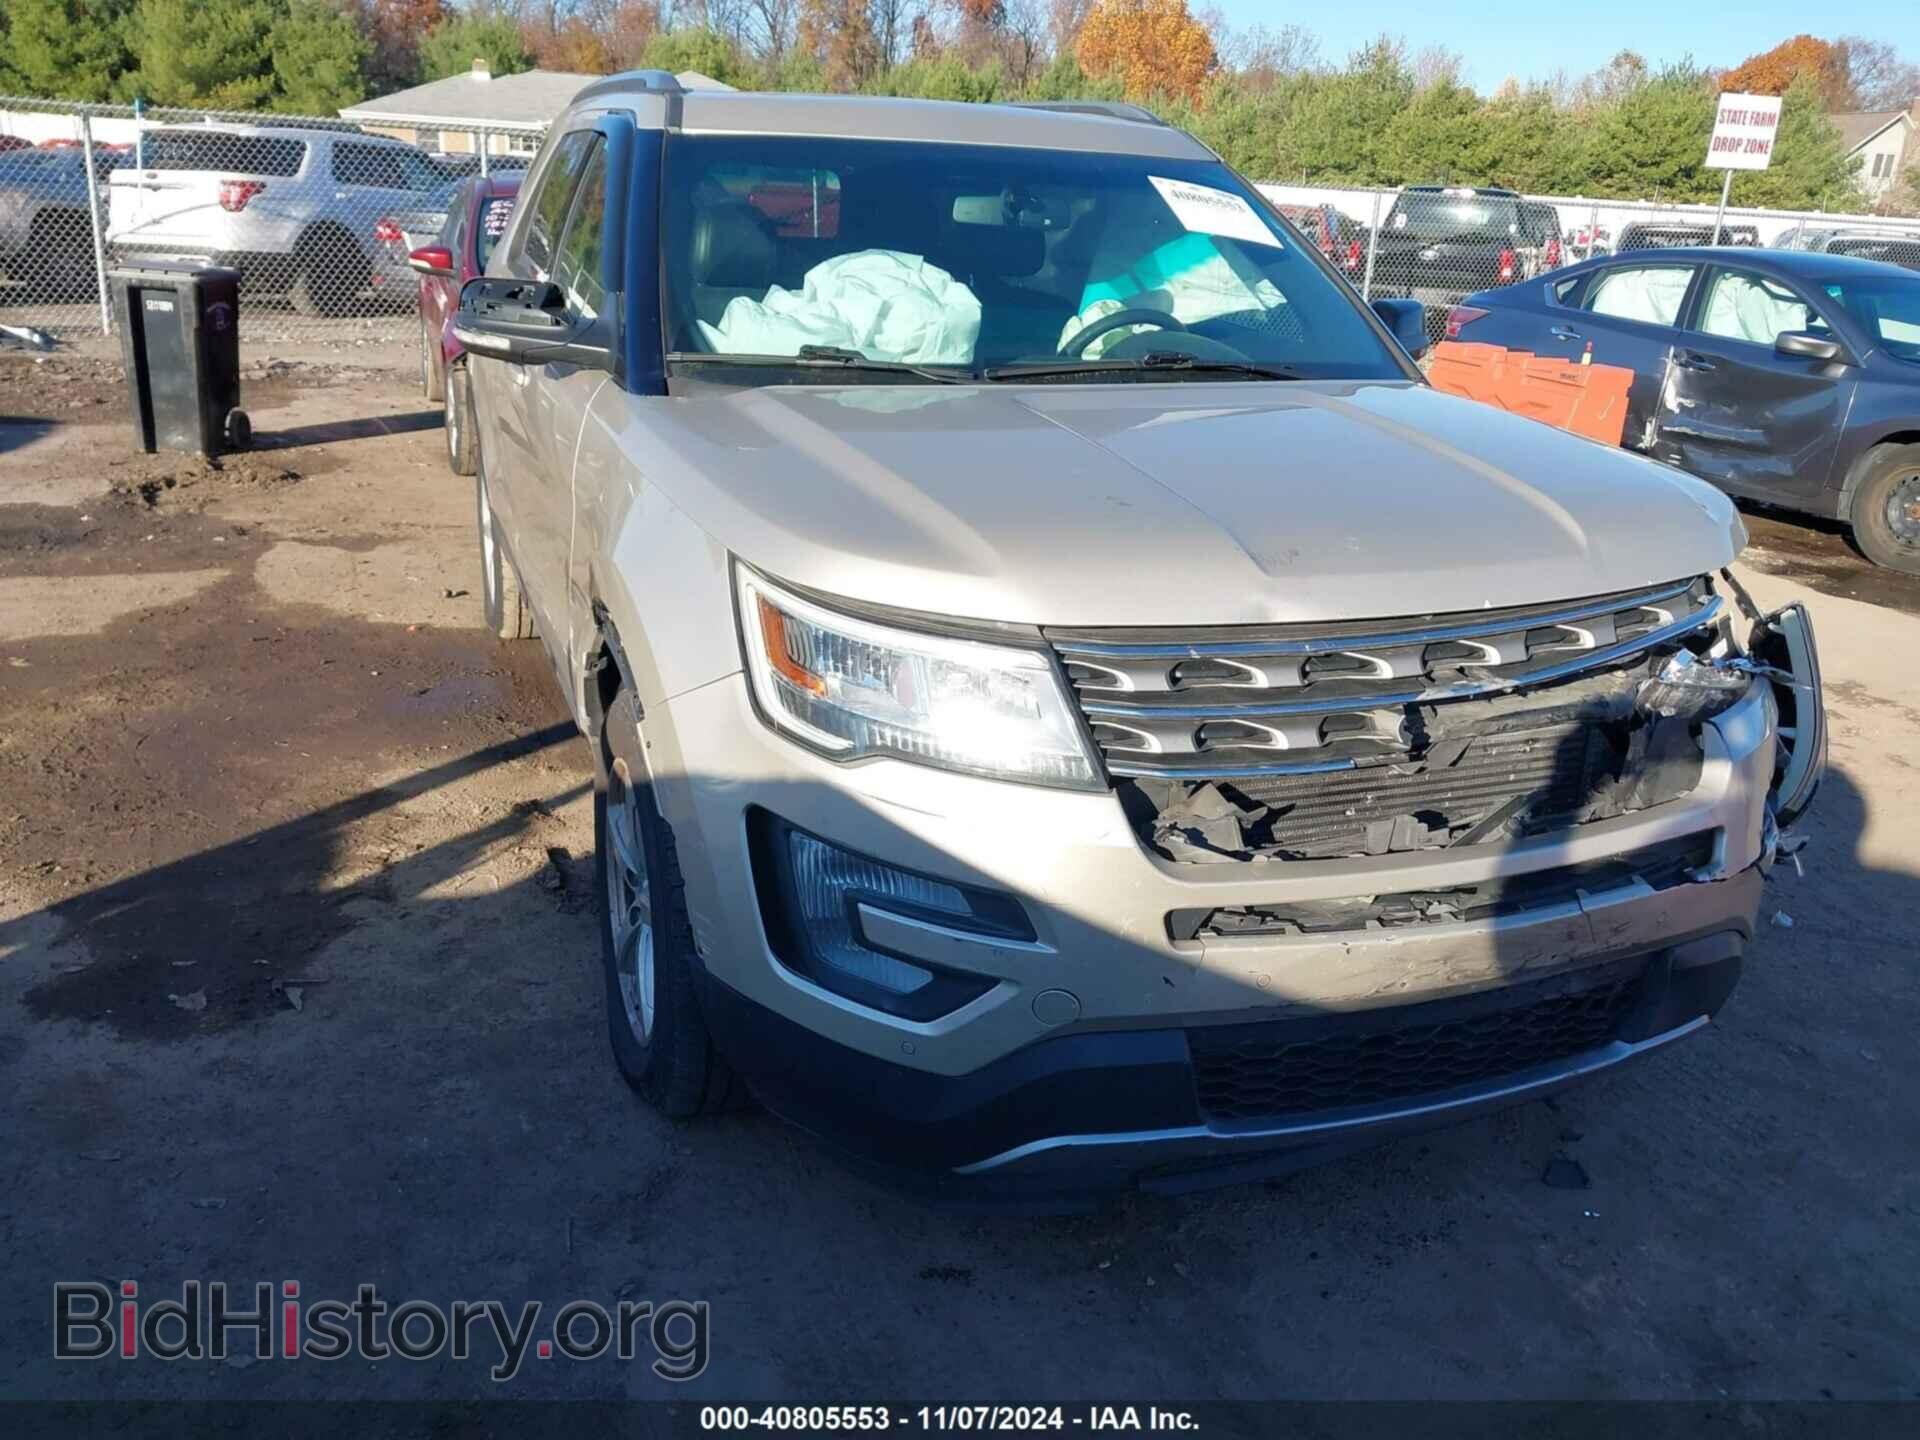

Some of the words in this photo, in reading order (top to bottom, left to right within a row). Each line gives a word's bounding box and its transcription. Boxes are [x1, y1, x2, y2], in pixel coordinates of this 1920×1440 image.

[1718, 108, 1748, 126] STATE
[1749, 110, 1777, 128] FARM
[1712, 135, 1743, 153] DROP
[1744, 137, 1771, 155] ZONE
